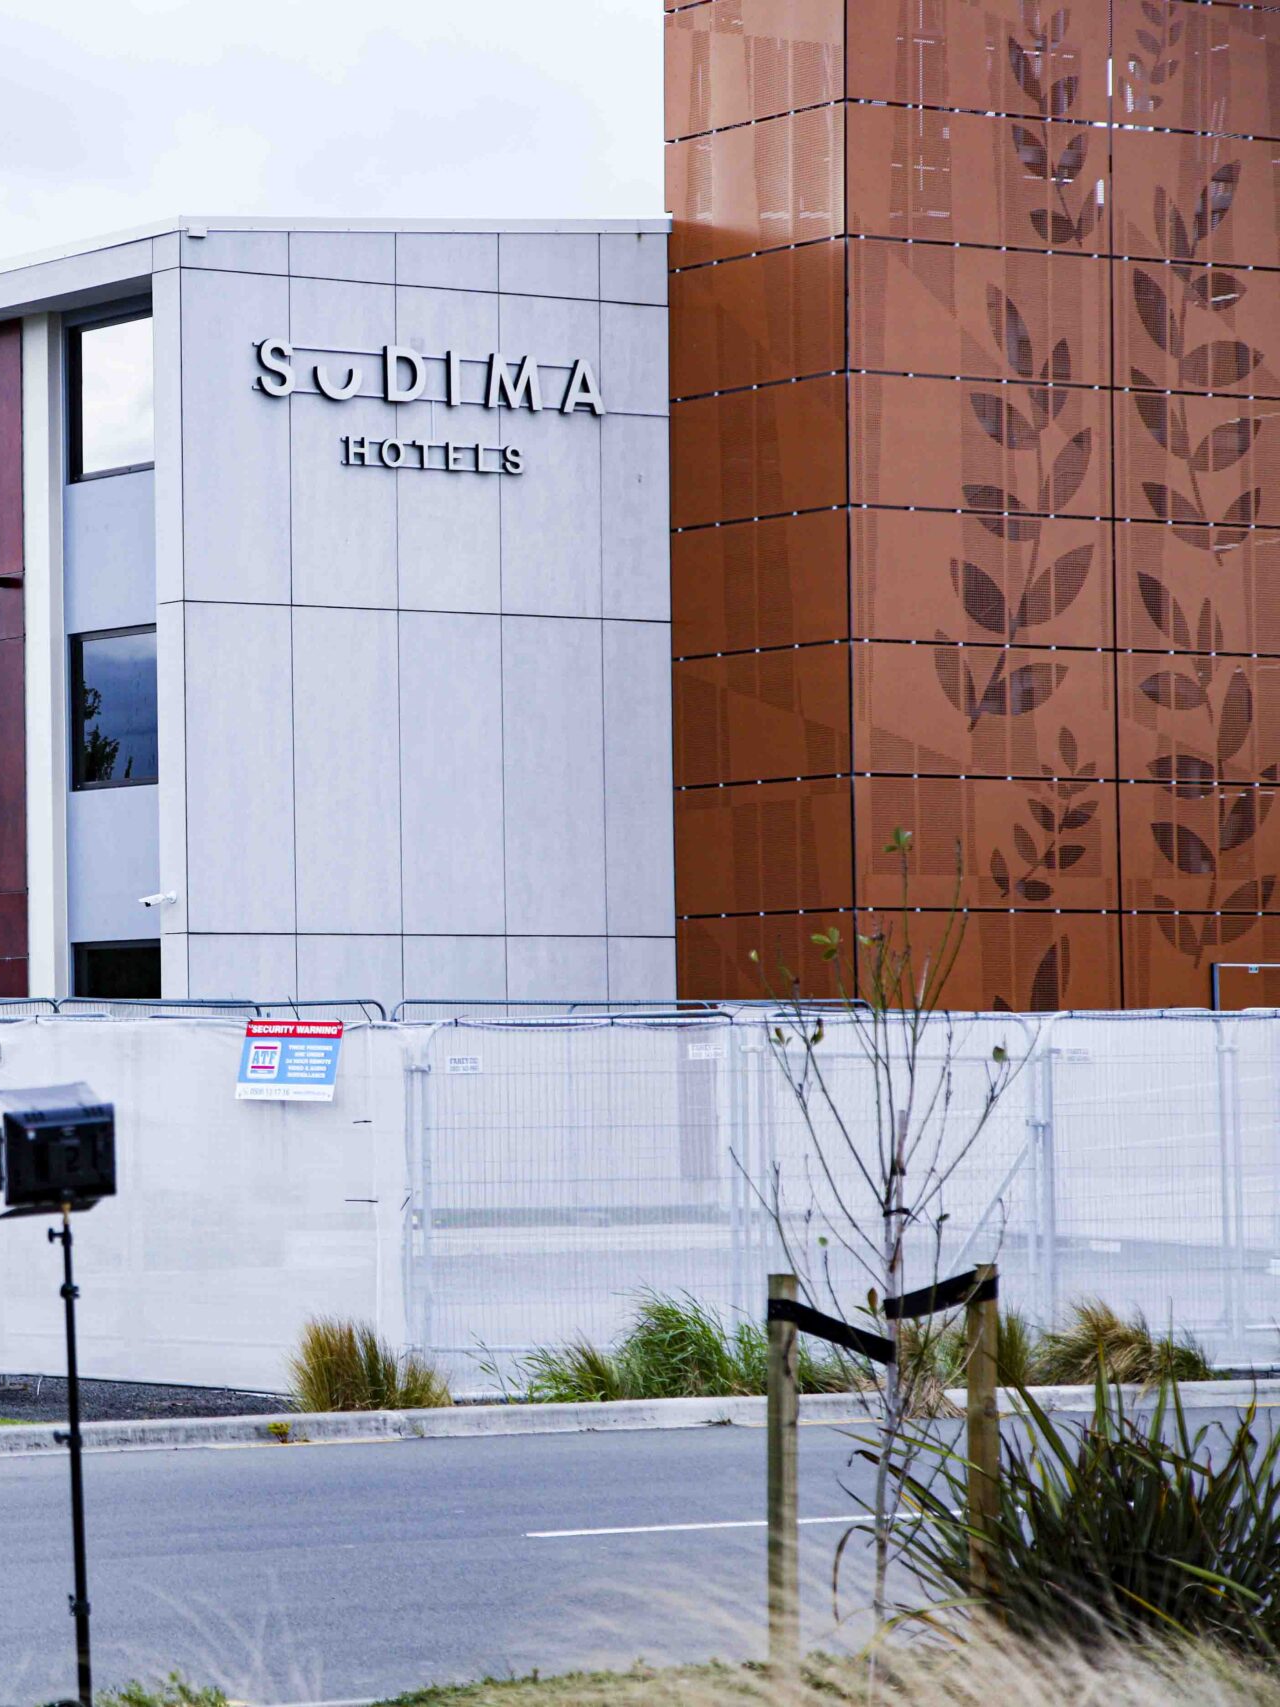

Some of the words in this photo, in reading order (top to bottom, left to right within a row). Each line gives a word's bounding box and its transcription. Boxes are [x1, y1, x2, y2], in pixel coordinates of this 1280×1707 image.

[257, 338, 606, 416] SUDIMA
[345, 436, 524, 475] HOTELS
[252, 1050, 277, 1065] ATF
